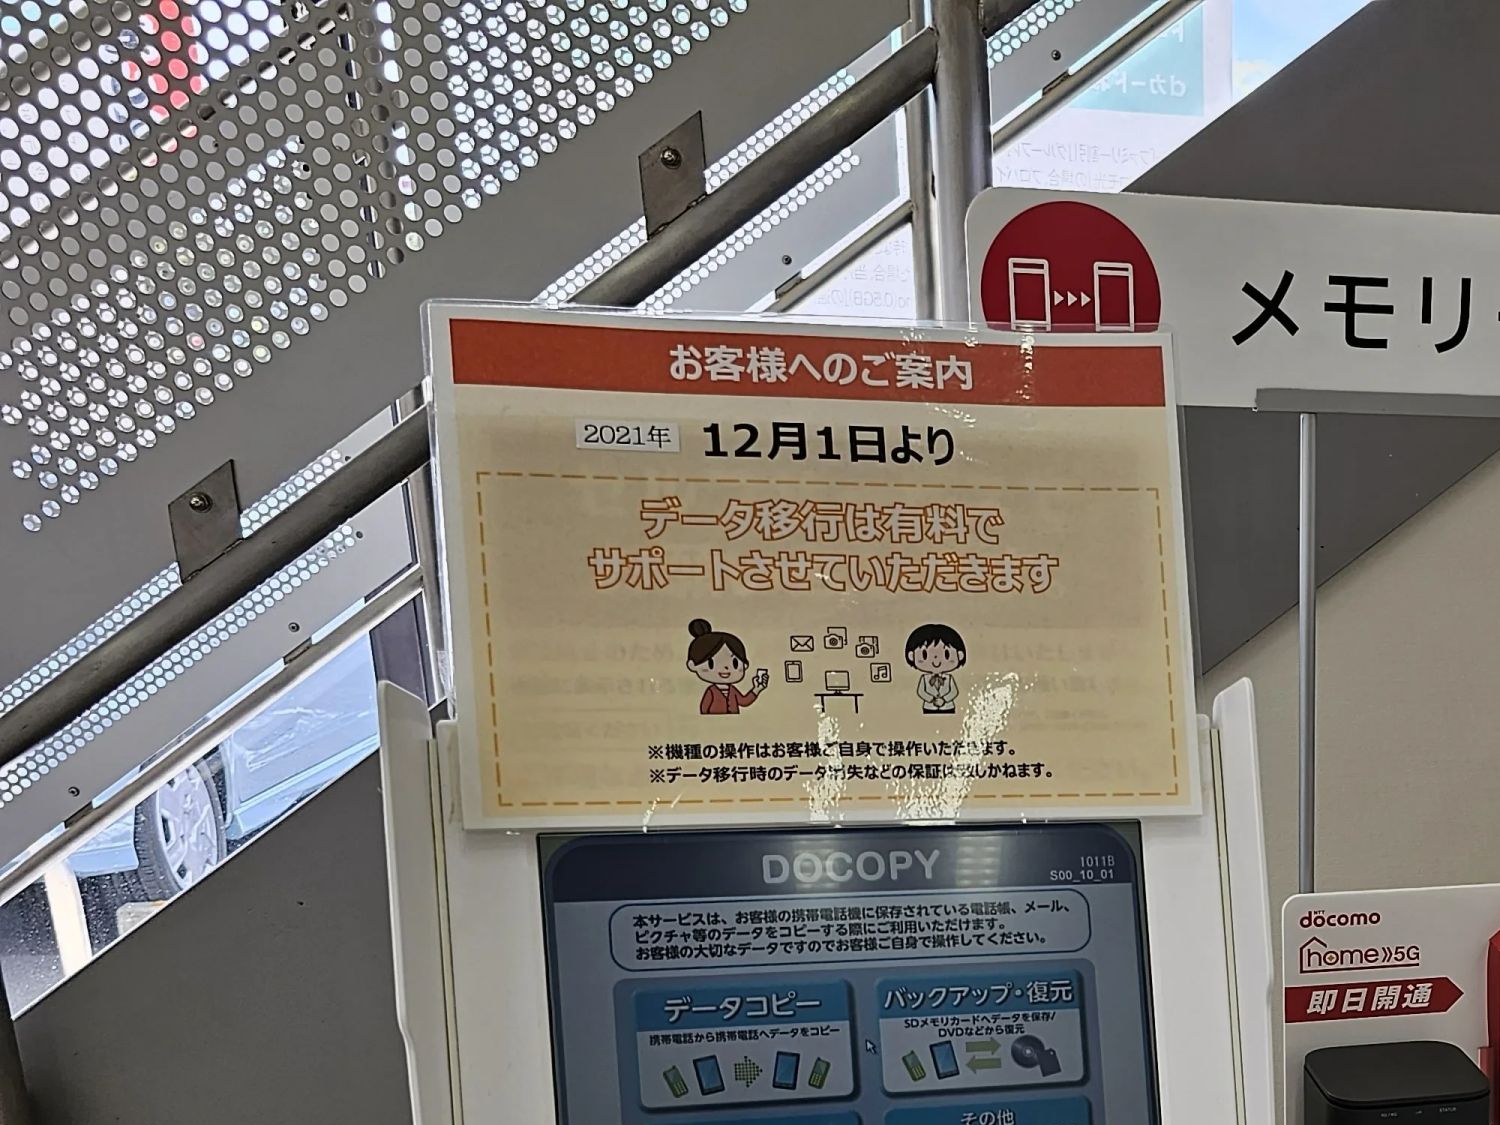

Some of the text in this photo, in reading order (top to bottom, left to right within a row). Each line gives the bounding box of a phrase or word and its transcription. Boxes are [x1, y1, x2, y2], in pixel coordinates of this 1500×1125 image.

[669, 343, 974, 391] お客様へのご案内
[582, 420, 956, 466] 2021年 12月1日より
[638, 497, 1003, 548] データ移行は有料で
[587, 547, 1059, 594] サポートさせていただきます
[761, 848, 942, 886] DOCOPY
[1299, 910, 1381, 928] docomo
[663, 990, 822, 1024] データコピー
[883, 980, 1074, 1009] バックアップ・復元
[1306, 982, 1434, 1015] 即日開通
